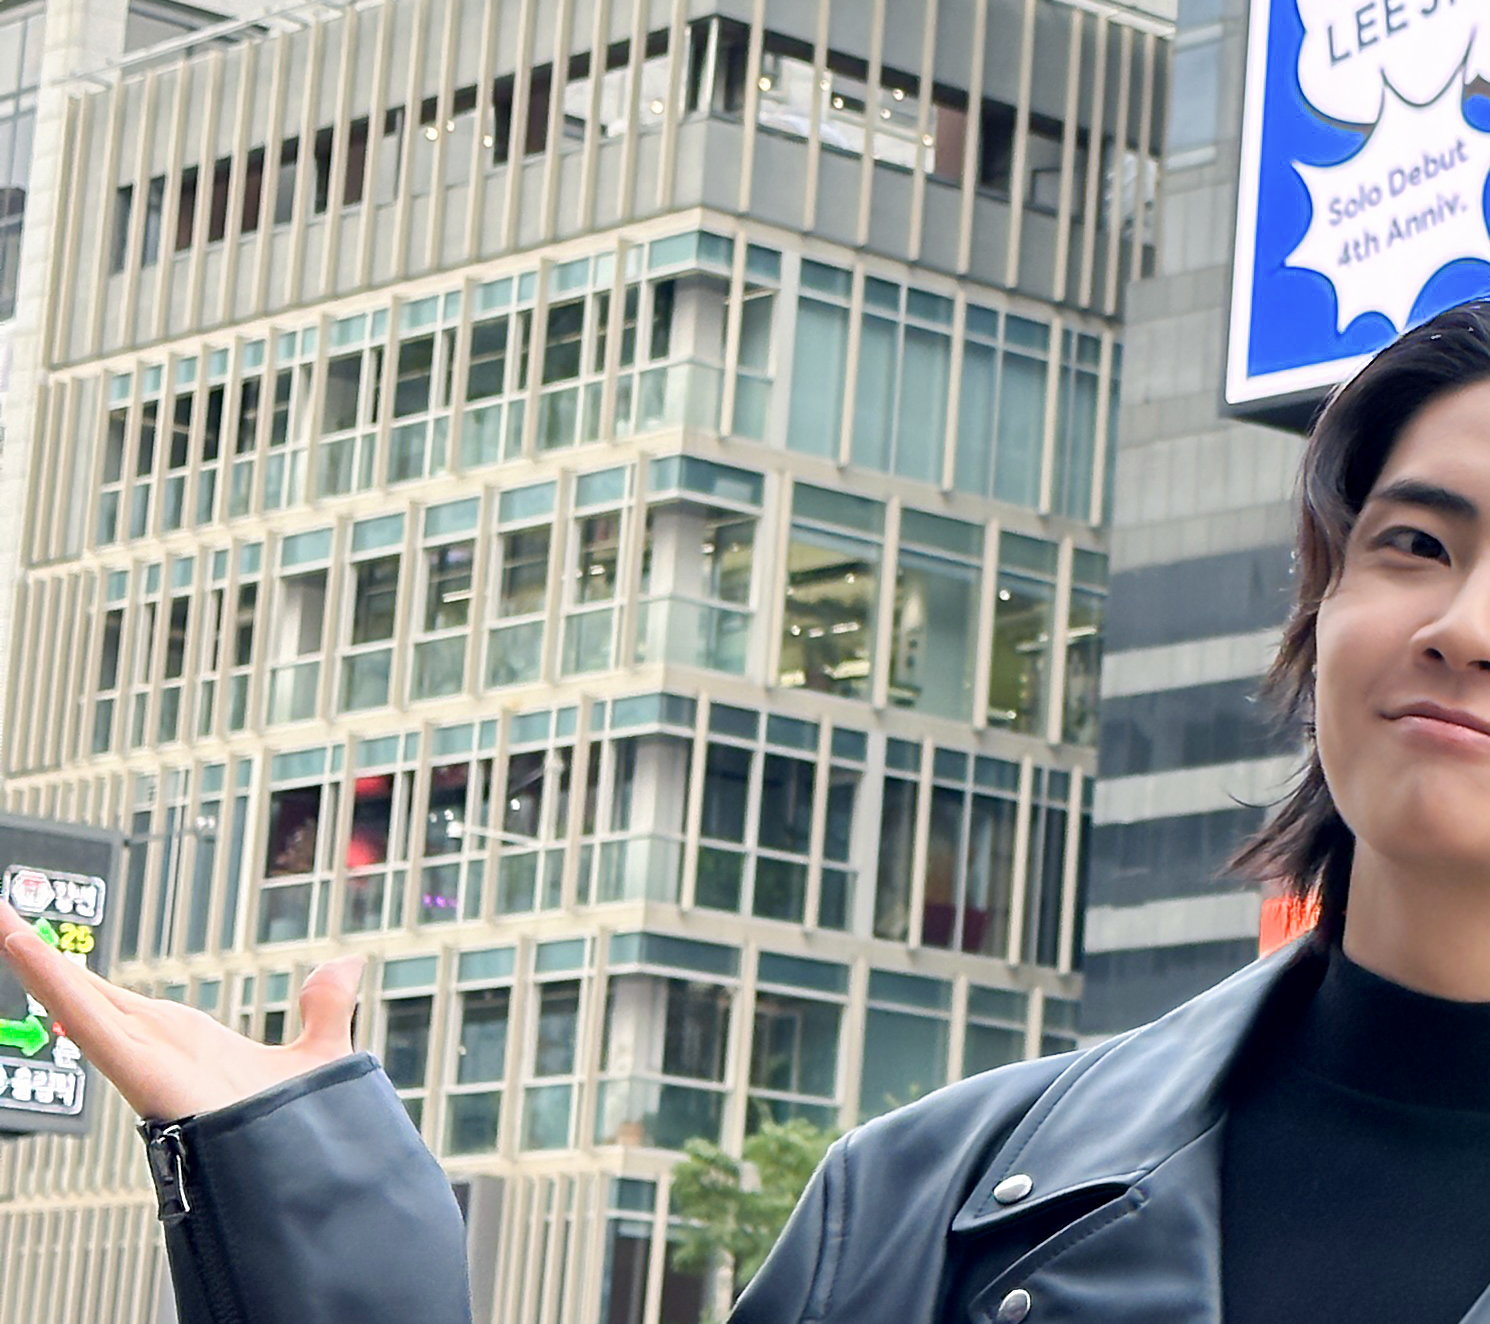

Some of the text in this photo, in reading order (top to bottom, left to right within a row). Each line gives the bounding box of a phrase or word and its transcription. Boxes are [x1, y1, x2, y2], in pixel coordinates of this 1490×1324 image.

[1328, 138, 1469, 227] Solo Debut
[1337, 192, 1468, 266] 4th Anniv.
[59, 922, 95, 953] 25
